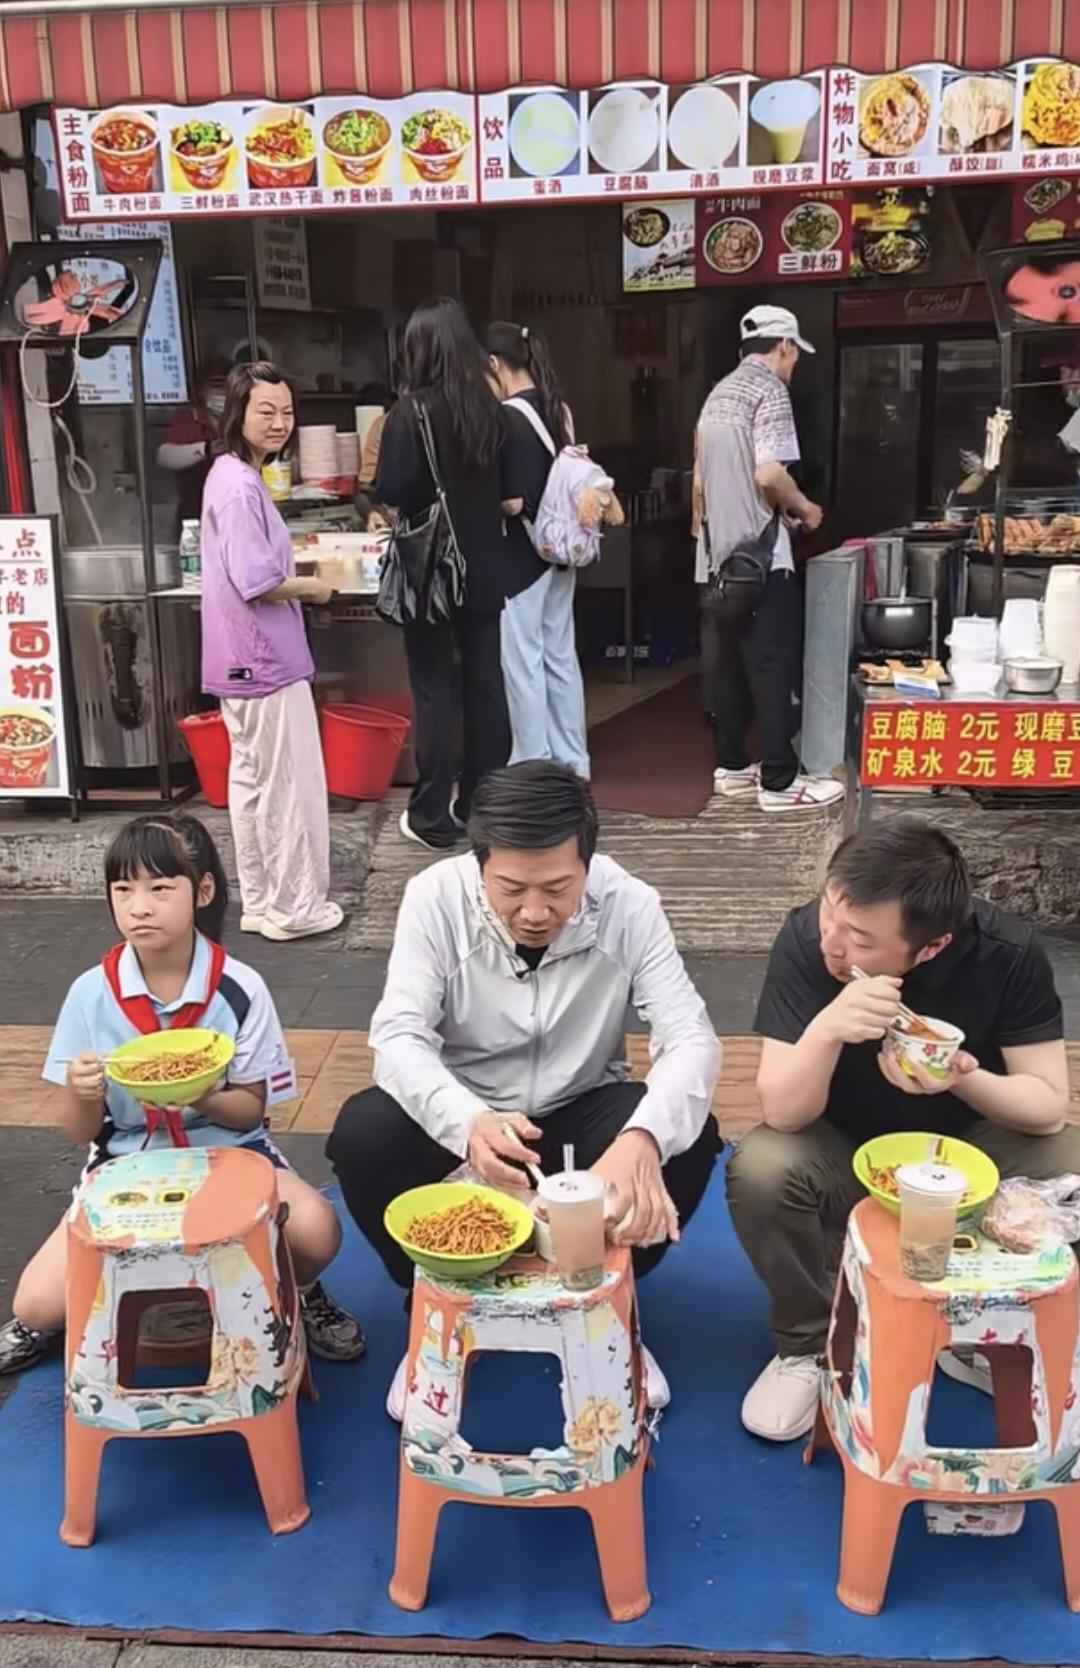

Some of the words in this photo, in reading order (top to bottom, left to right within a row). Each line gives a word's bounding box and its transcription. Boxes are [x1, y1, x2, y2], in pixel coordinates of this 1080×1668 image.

[831, 73, 856, 181] 炸物小吃
[483, 116, 504, 180] 饮品
[62, 114, 91, 213] 主食粉面
[752, 165, 815, 185] 现磨豆浆
[180, 193, 240, 210] 三鲜粉面
[248, 189, 323, 207] 武汉热干面
[332, 186, 393, 204] 炸酱粉面
[409, 184, 470, 201] 肉丝粉面
[103, 196, 162, 212] 牛肉粉面
[781, 253, 838, 273] 三鲜粉
[869, 709, 947, 741] 豆腐脑
[960, 712, 999, 741] 2元
[866, 746, 943, 778] 矿泉水
[957, 749, 996, 778] 2元
